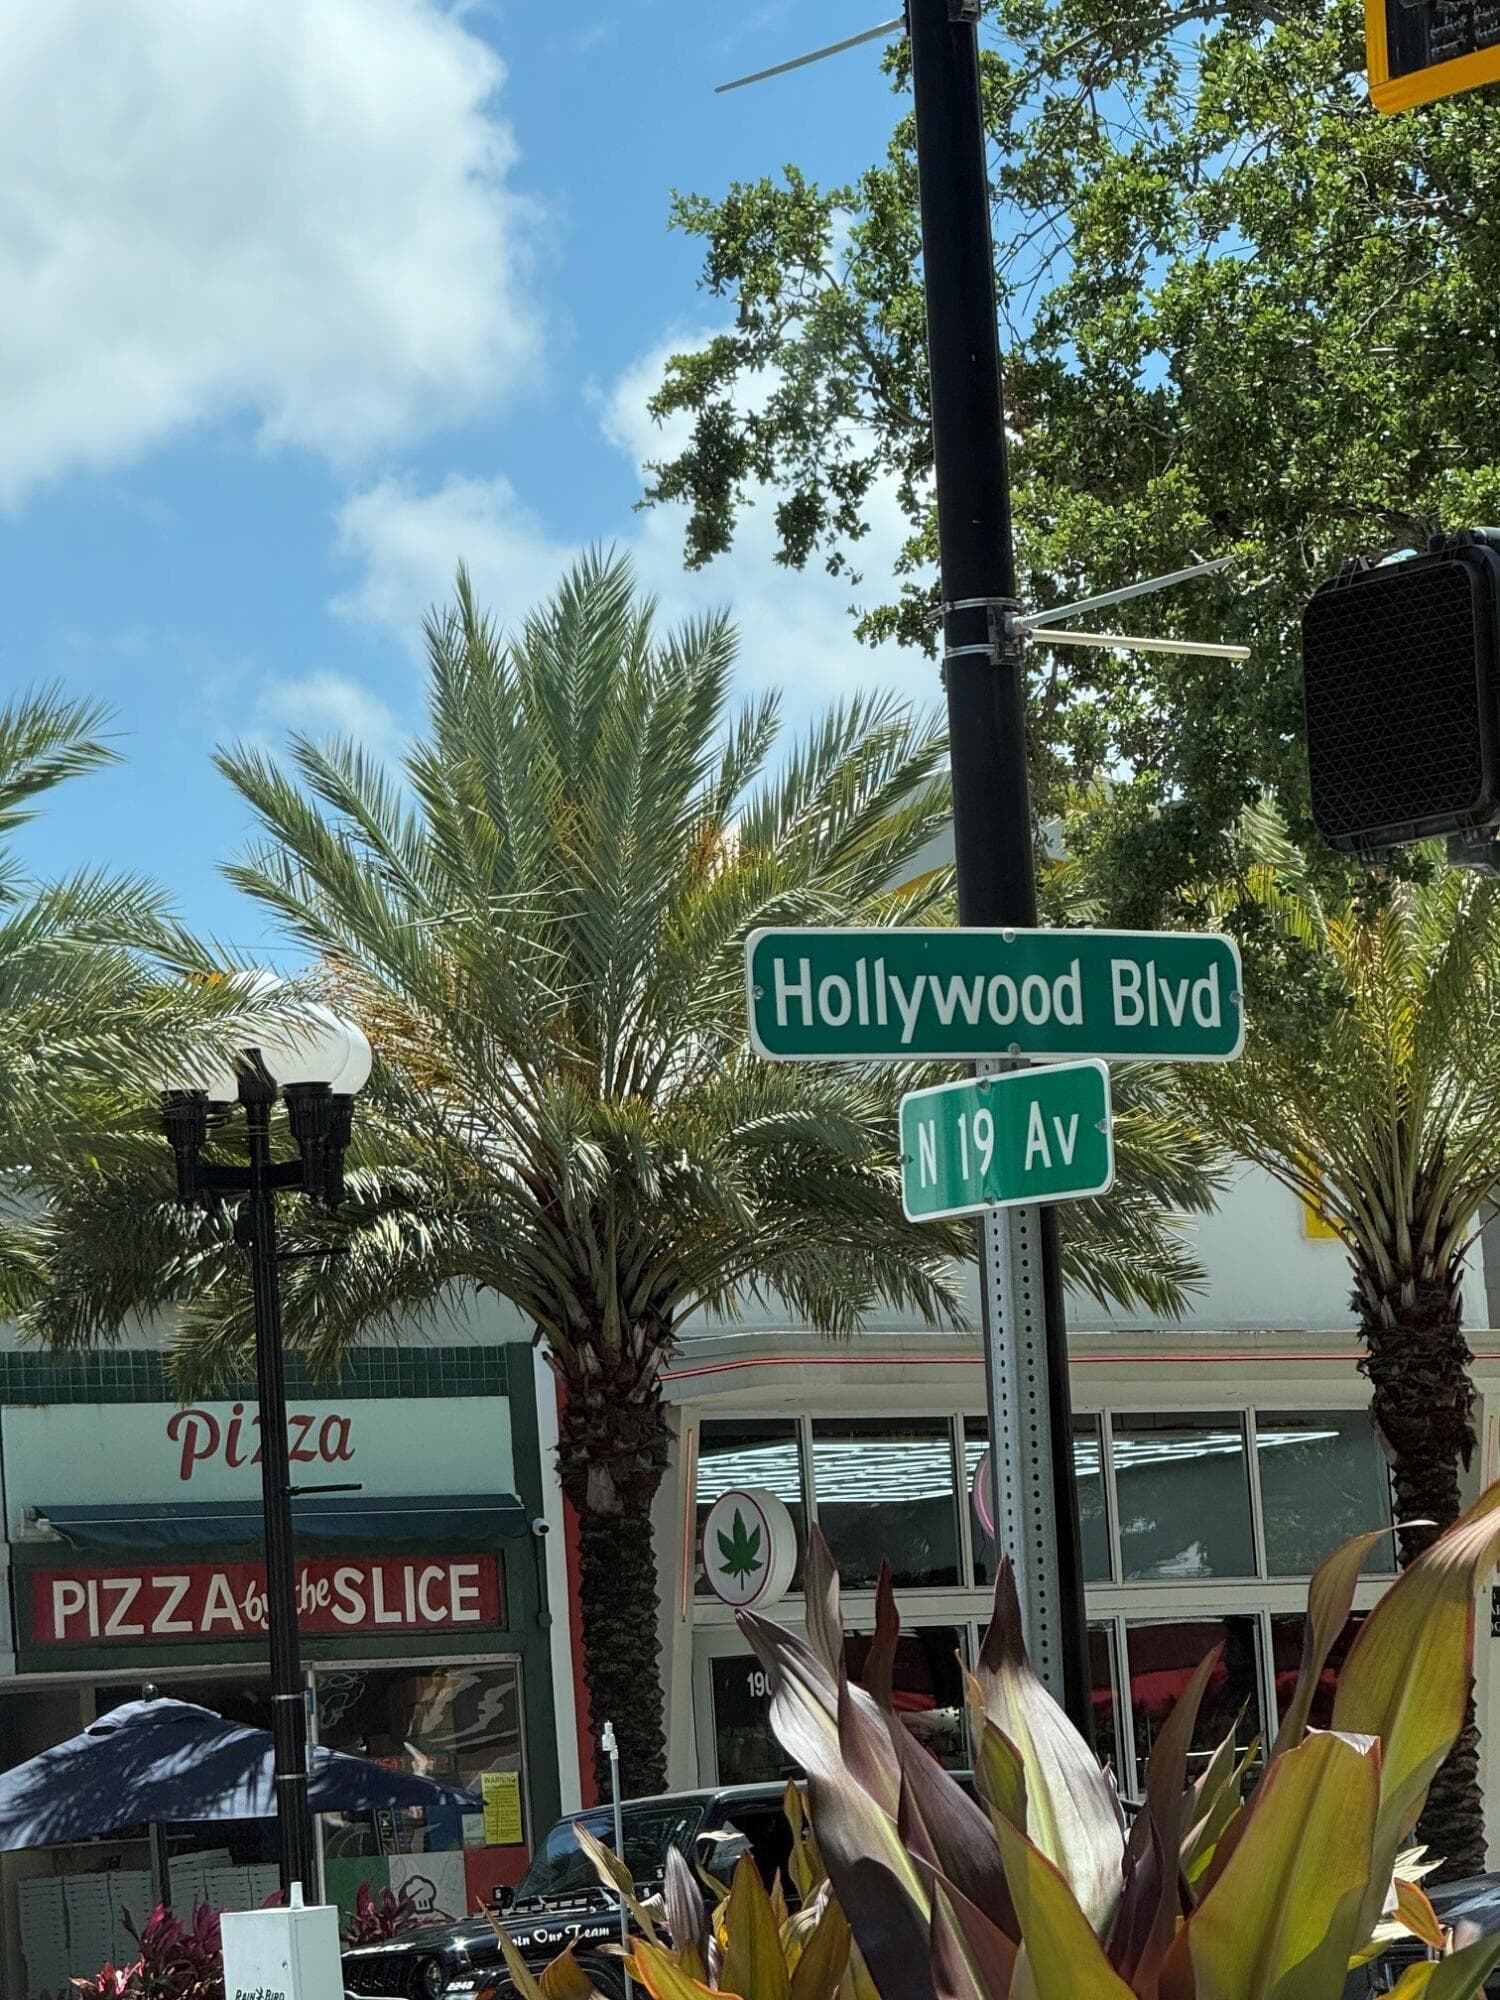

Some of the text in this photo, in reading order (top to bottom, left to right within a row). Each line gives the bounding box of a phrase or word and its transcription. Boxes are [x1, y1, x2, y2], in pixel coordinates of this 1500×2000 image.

[773, 956, 1222, 1044] Hollywood Blvd
[918, 1100, 1079, 1188] N 19 Av
[52, 1573, 245, 1639] PIZZA
[295, 1568, 331, 1615] he
[331, 1563, 481, 1625] SLICE
[533, 1929, 563, 1944] Our
[565, 1923, 610, 1939] Team
